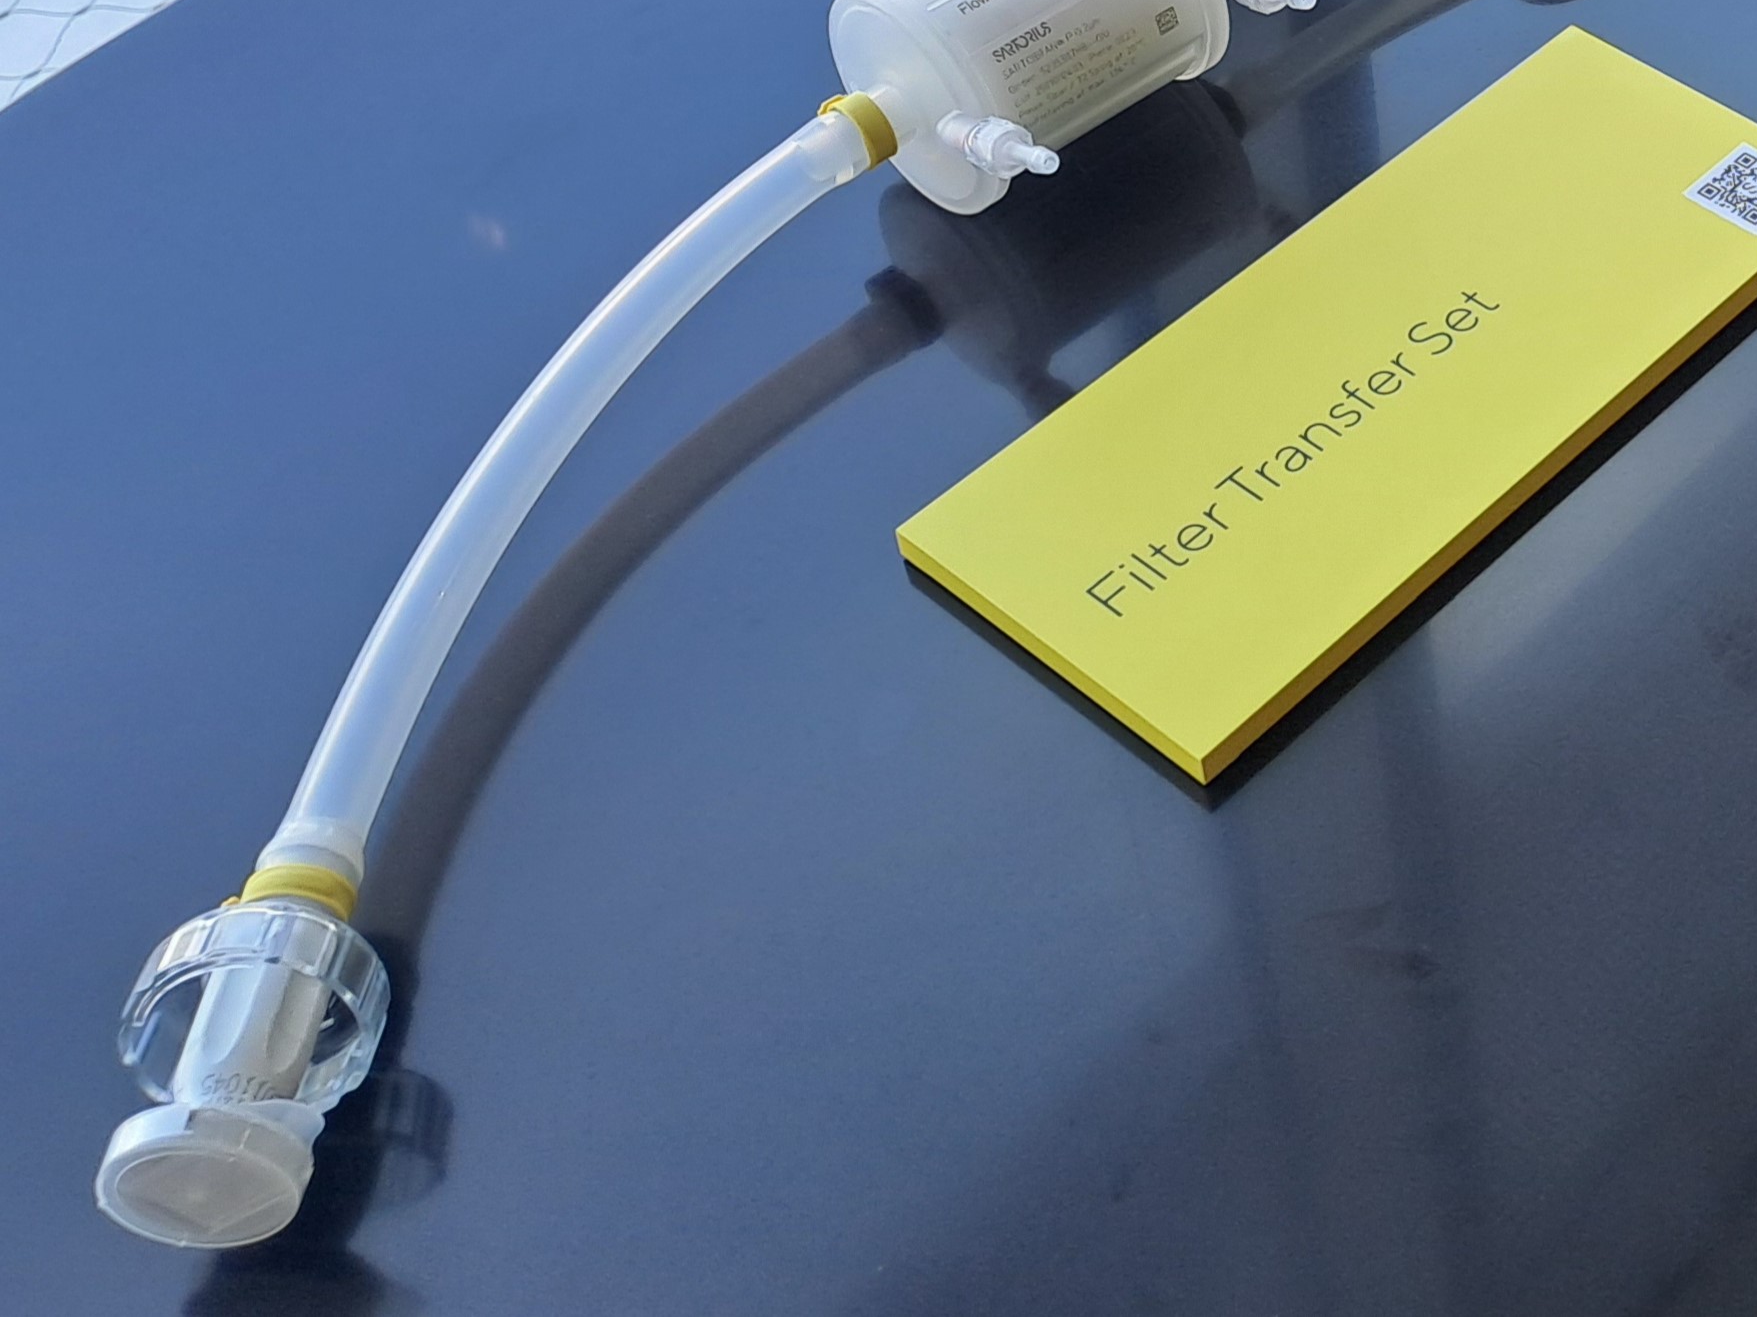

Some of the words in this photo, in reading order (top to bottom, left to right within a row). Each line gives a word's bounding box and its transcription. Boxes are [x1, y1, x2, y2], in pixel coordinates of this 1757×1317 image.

[992, 22, 1052, 63] SARTORIUS
[1085, 502, 1229, 617] Filter
[1214, 352, 1416, 502] Transfer
[1408, 291, 1500, 355] Set
